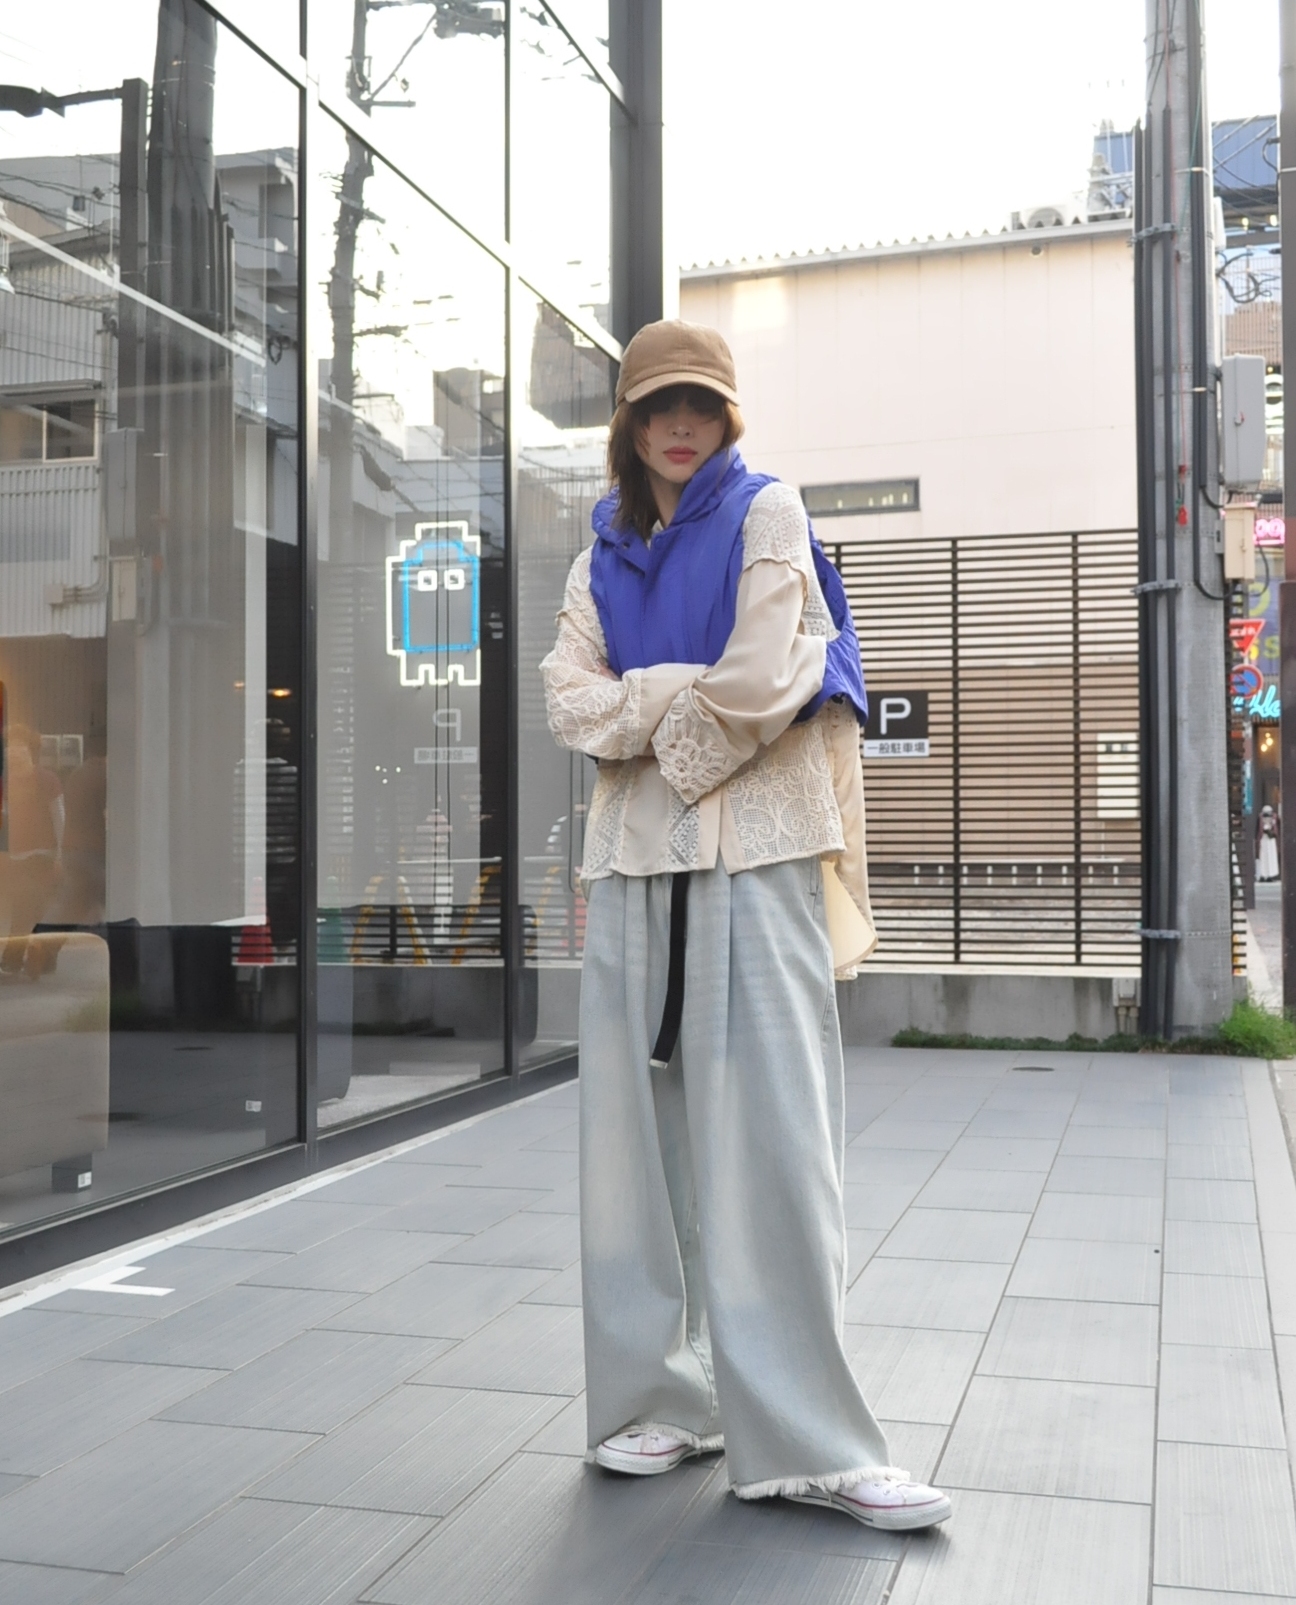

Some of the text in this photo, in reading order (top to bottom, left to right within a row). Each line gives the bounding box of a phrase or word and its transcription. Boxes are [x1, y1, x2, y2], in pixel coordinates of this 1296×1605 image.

[880, 697, 911, 735] P
[867, 742, 926, 754] 一般駐車場
